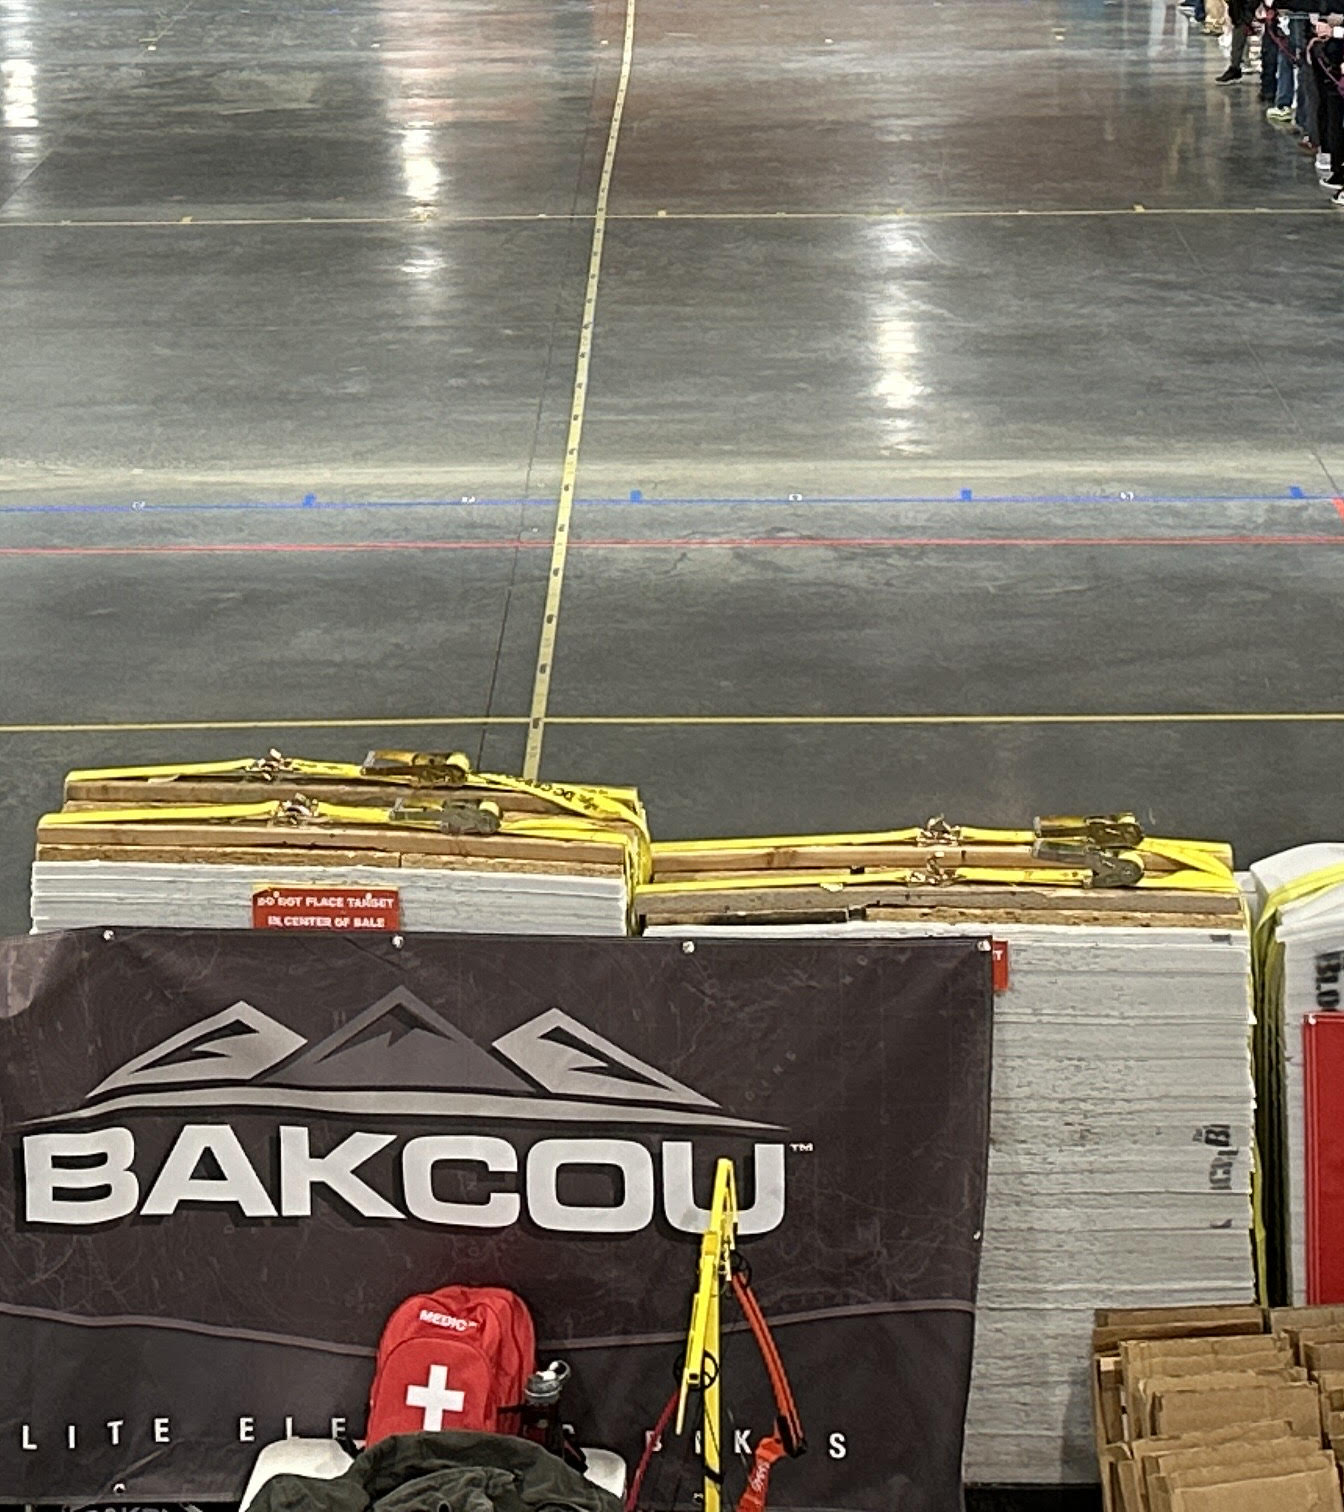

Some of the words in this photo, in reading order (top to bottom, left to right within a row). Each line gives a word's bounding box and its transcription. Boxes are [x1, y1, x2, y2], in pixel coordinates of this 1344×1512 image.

[284, 916, 332, 927] CENTER
[334, 917, 349, 927] OF
[22, 1123, 786, 1235] BAKCOU
[645, 1428, 847, 1460] BIKS
